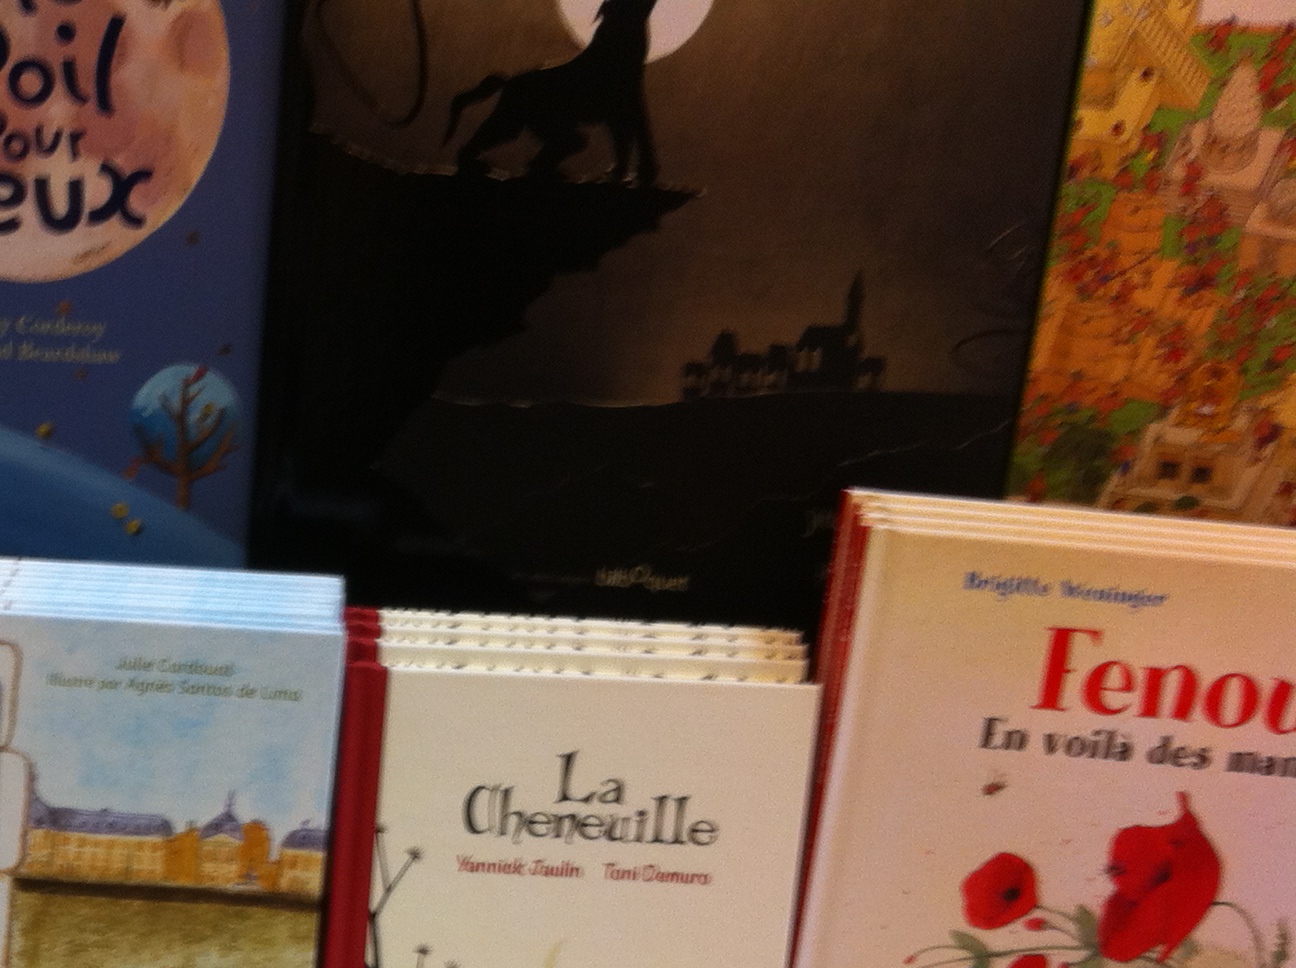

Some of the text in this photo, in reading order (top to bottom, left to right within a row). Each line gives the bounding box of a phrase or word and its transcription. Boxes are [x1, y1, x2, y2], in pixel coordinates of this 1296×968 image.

[977, 715, 1030, 752] En
[1042, 728, 1135, 763] voilà
[1145, 735, 1213, 771] des
[554, 750, 626, 805] La
[462, 783, 720, 846] Cheneuille
[456, 853, 526, 877] Yannick
